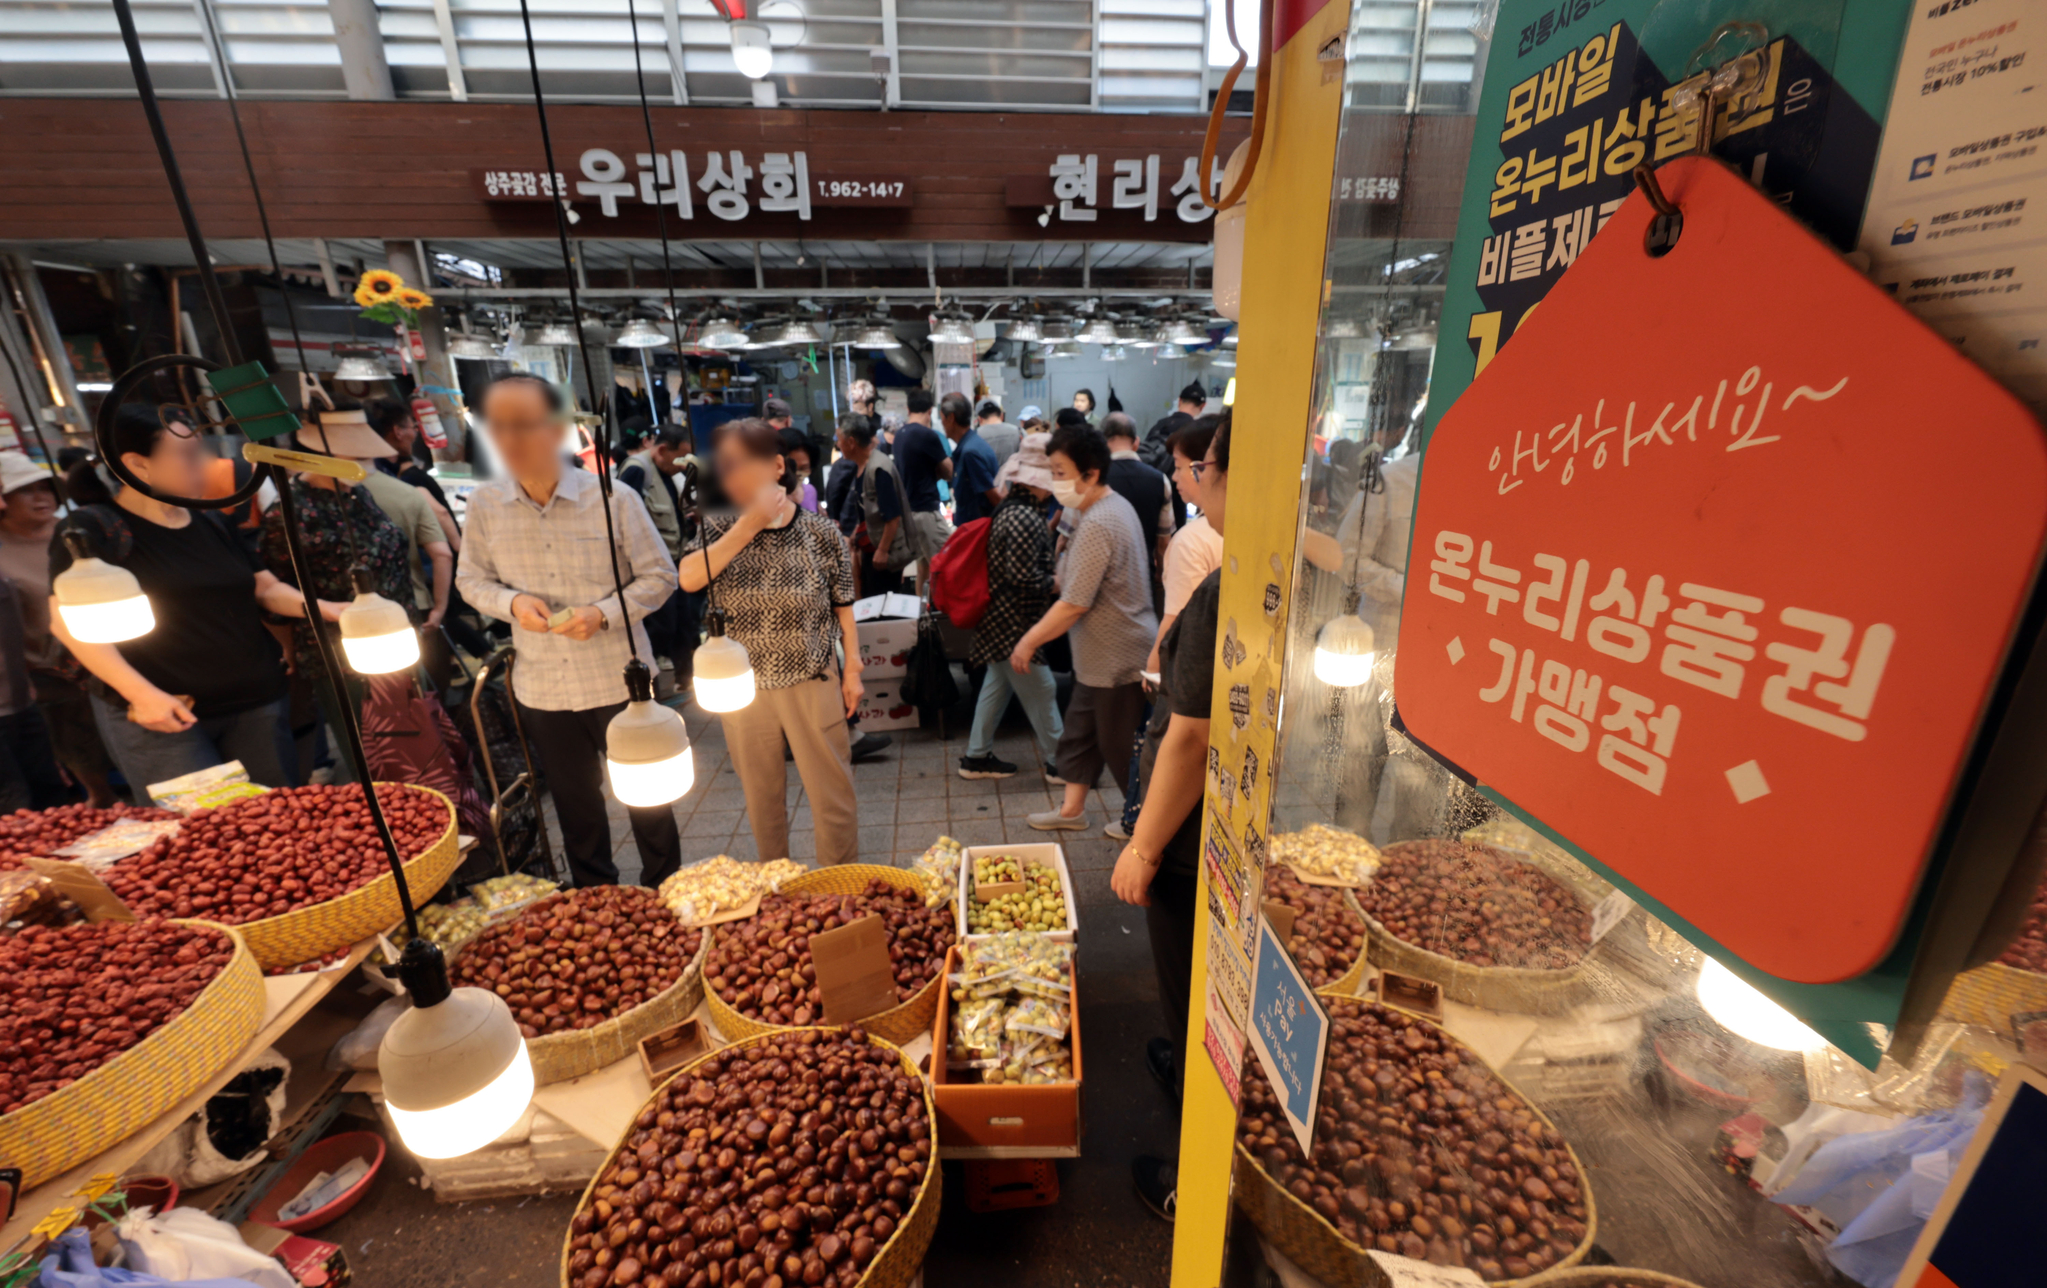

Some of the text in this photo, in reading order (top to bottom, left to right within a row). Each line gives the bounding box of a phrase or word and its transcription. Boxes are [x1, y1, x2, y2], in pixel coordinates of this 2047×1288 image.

[1501, 23, 1621, 143] 모바일
[1921, 70, 1967, 96] 전통시장
[1960, 45, 1998, 66] 누구나
[576, 148, 811, 221] 우리상회
[1050, 154, 1225, 223] 현리상
[1429, 530, 1896, 741] 온누리상품권
[1479, 638, 1682, 796] 가맹점
[1274, 998, 1294, 1042] Pay
